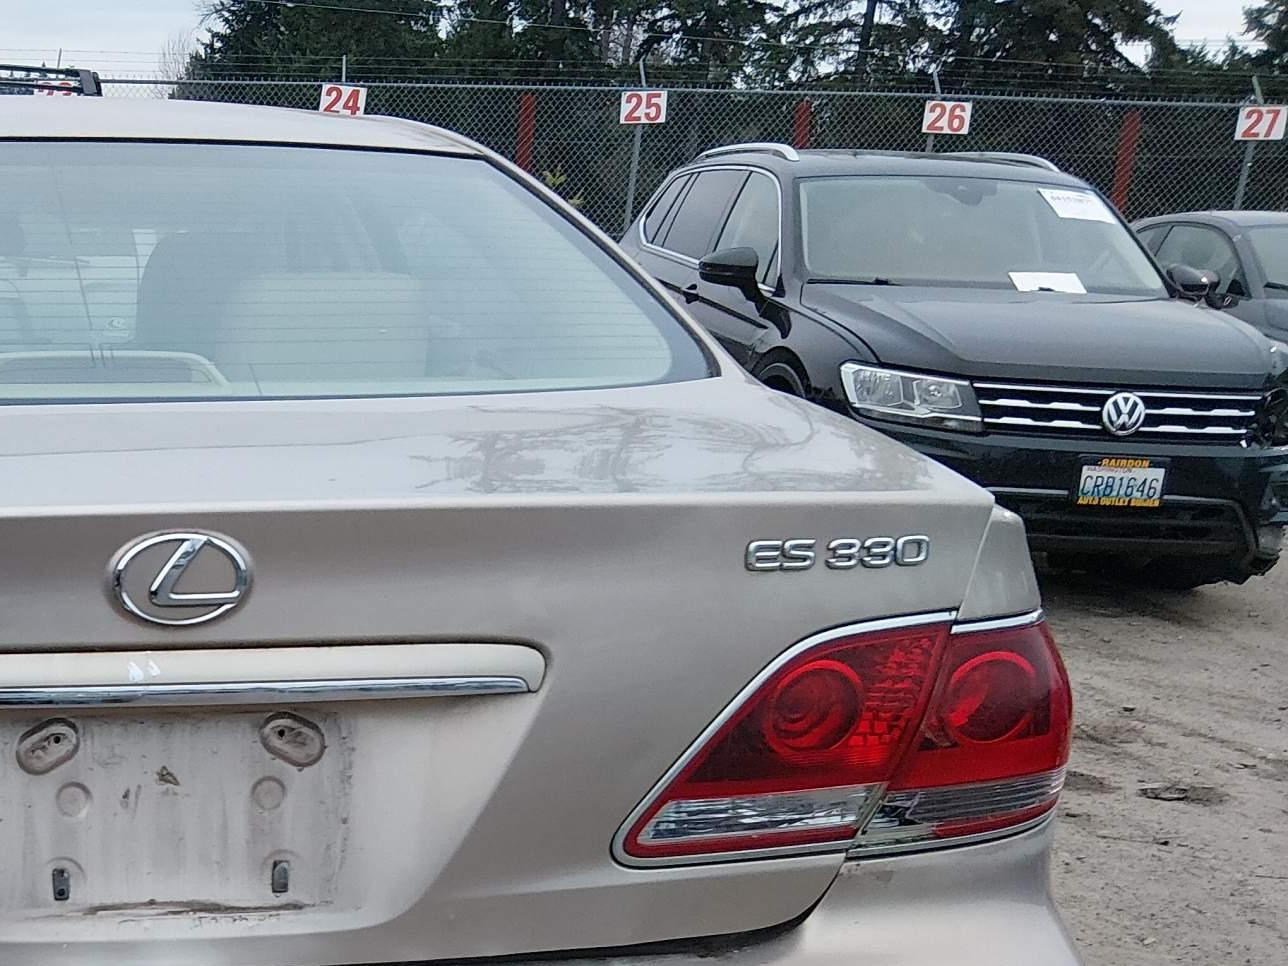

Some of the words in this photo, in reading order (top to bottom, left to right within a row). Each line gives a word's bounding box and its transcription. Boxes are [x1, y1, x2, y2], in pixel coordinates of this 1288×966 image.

[323, 87, 361, 115] 24
[624, 93, 662, 122] 25
[926, 103, 967, 132] 26
[1241, 109, 1282, 139] 27
[1080, 475, 1159, 498] CRB1646
[745, 539, 816, 571] ES
[825, 535, 929, 570] 330
